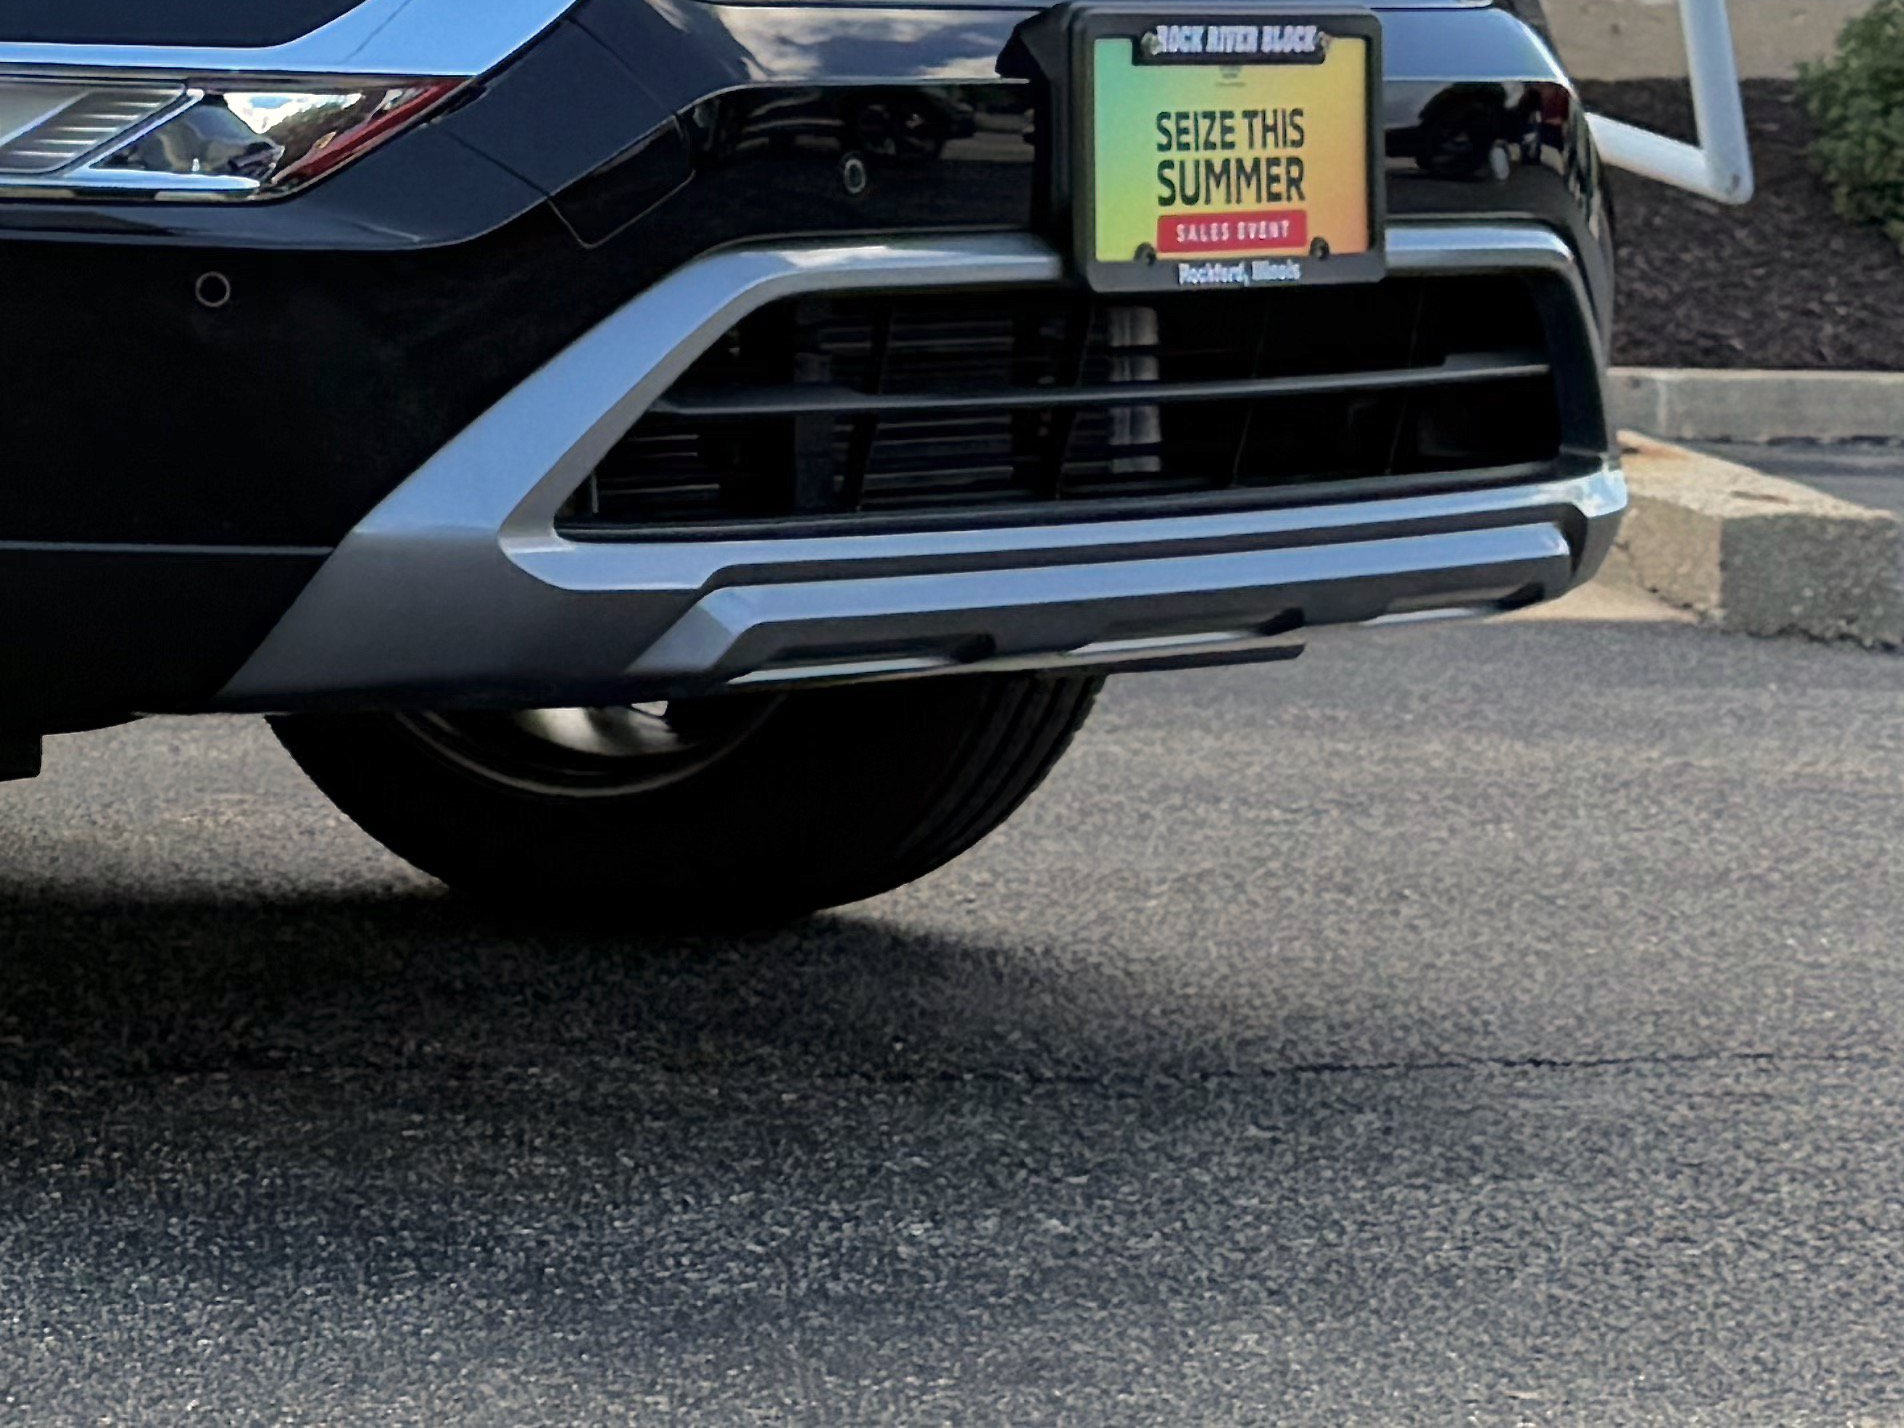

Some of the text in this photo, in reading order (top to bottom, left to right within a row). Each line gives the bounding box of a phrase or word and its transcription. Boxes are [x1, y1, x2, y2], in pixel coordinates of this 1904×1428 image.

[1156, 108, 1305, 153] SEIZE THIS
[1157, 156, 1306, 207] SUMMER
[1176, 220, 1290, 243] SALES EVENT
